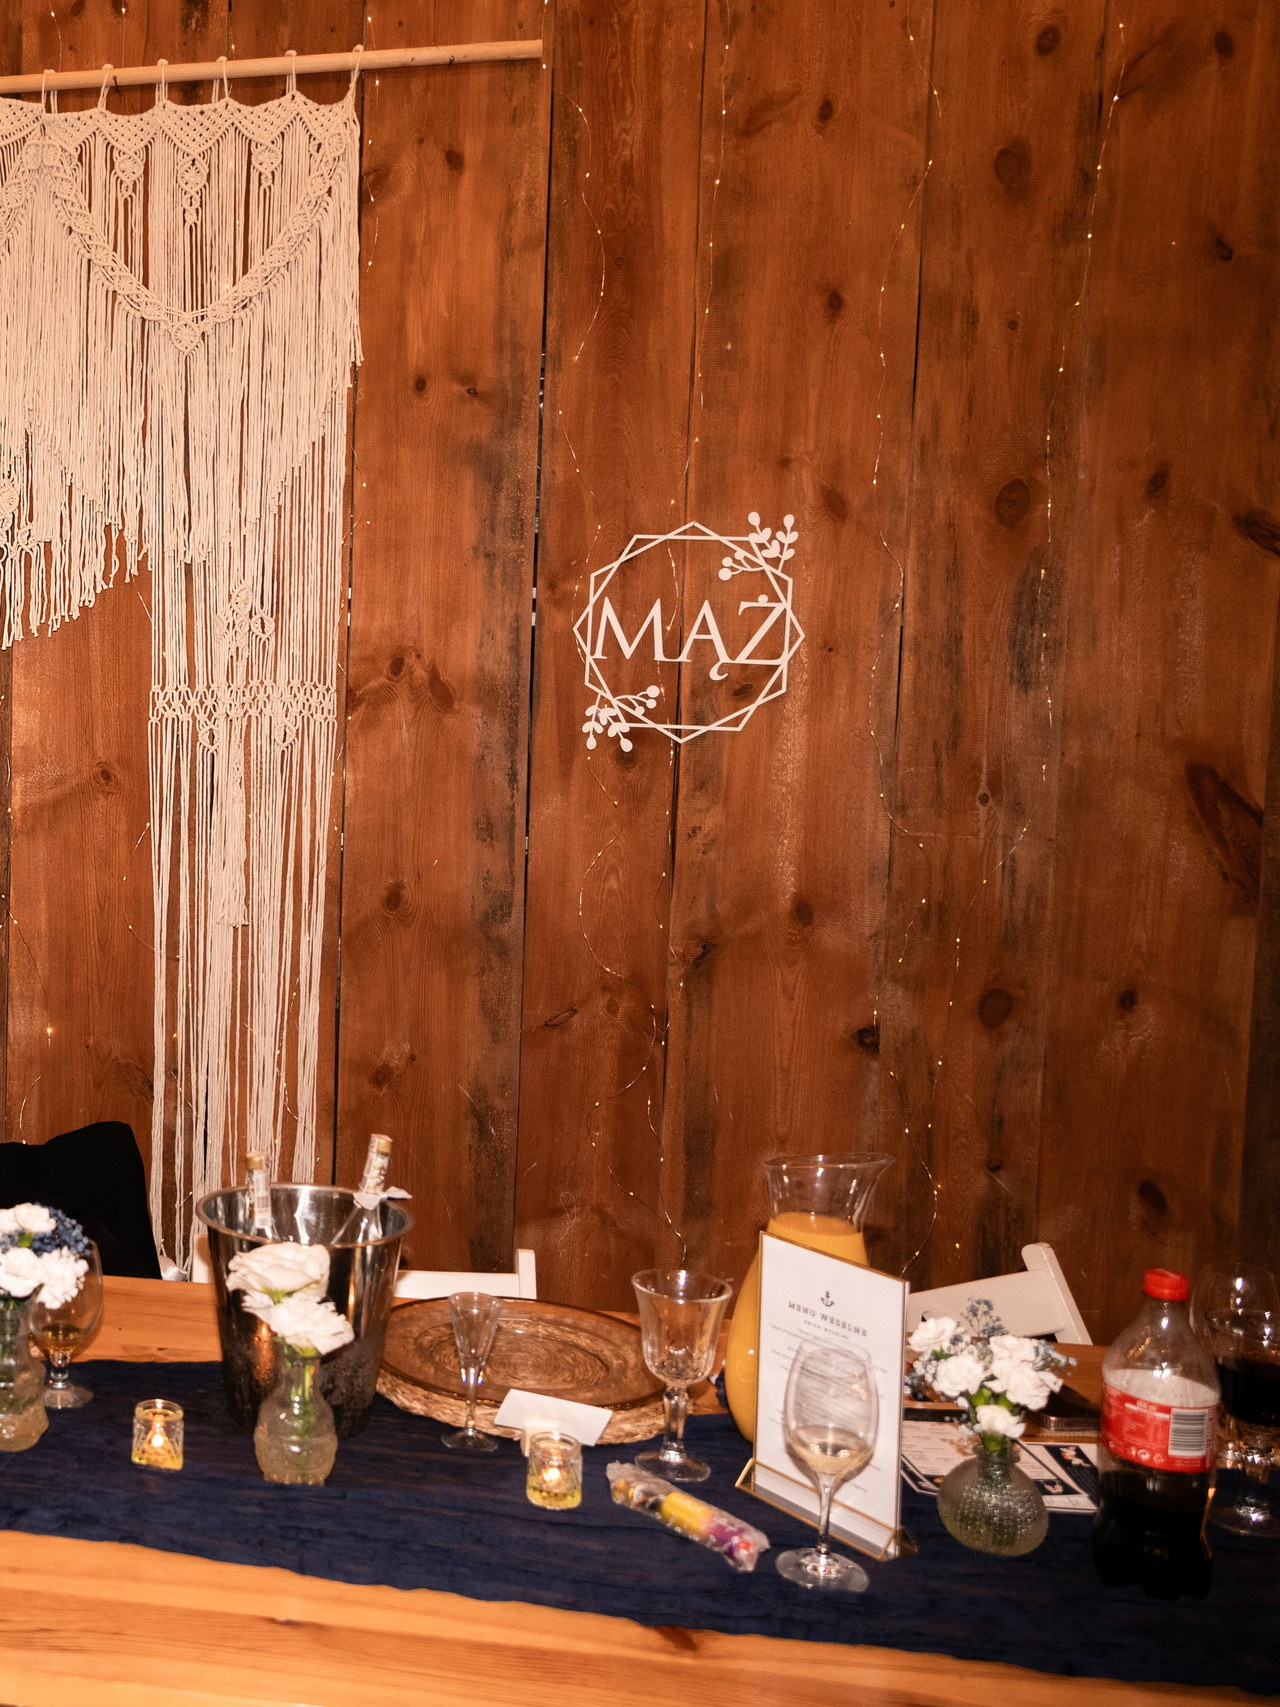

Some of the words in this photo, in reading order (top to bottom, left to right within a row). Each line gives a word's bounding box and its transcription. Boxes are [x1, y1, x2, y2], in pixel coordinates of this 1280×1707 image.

[590, 594, 788, 681] MĄŻ
[788, 1301, 816, 1317] MENU
[820, 1313, 868, 1337] WESELNE
